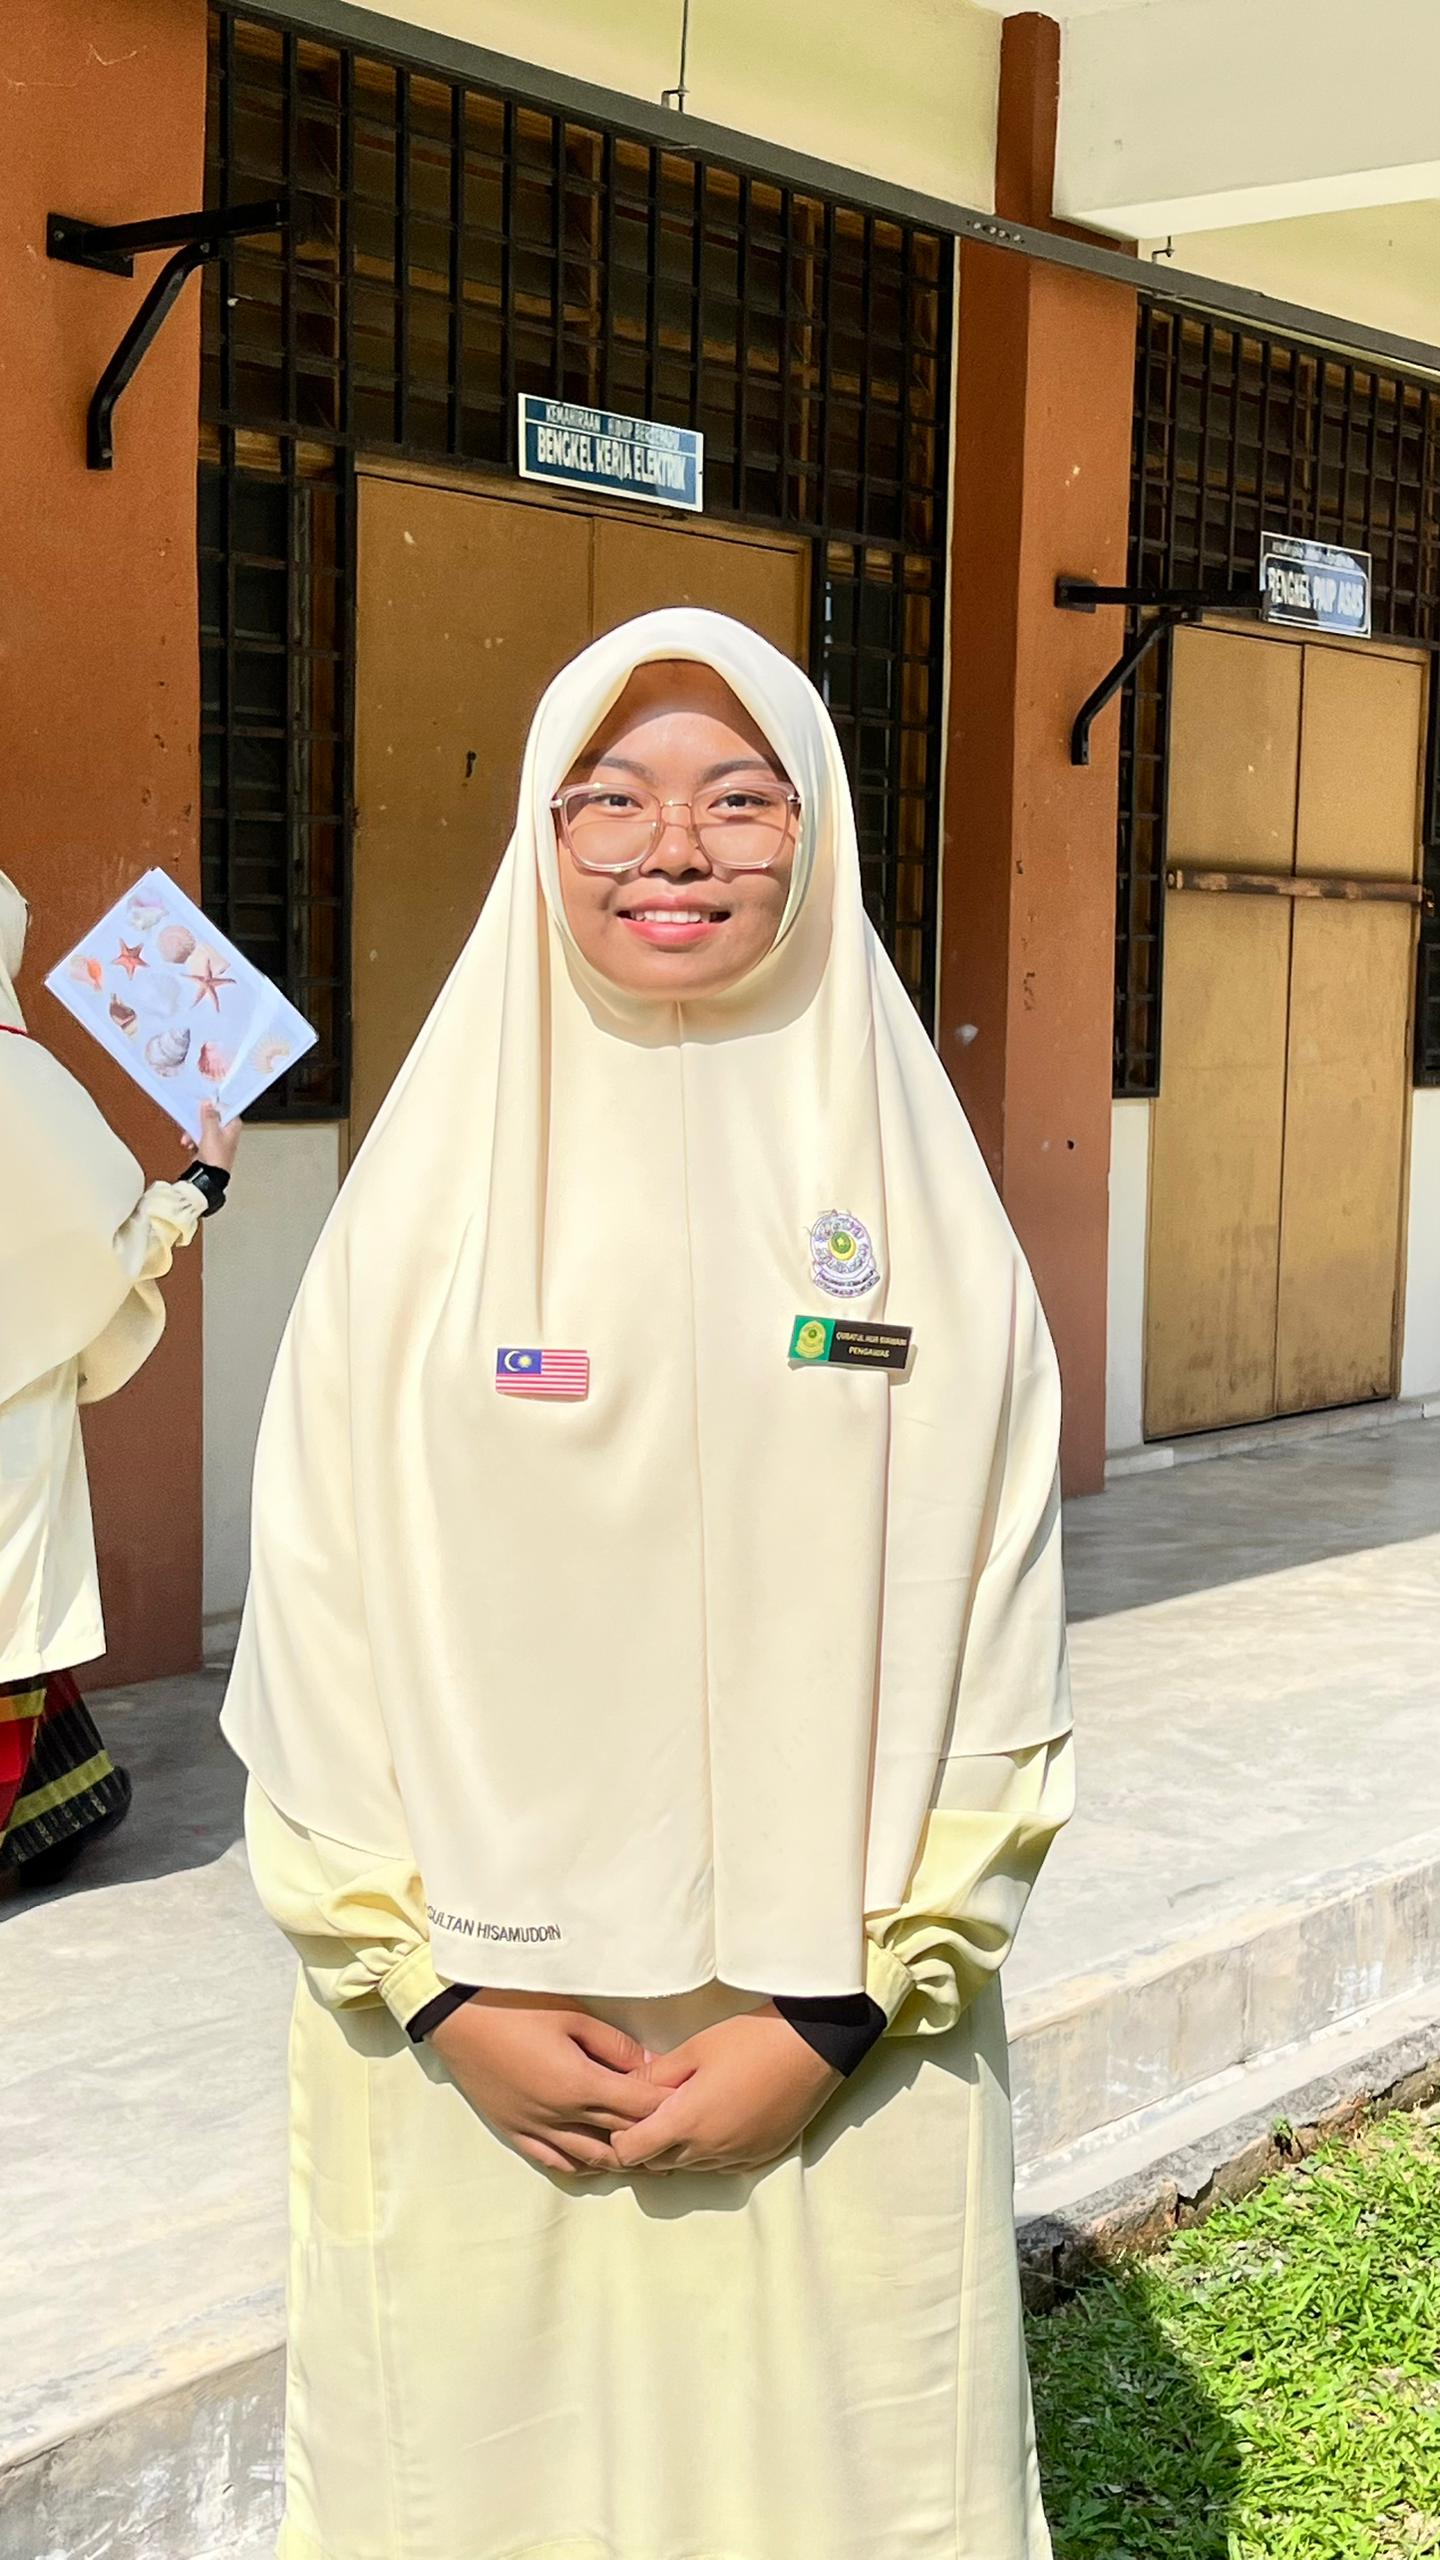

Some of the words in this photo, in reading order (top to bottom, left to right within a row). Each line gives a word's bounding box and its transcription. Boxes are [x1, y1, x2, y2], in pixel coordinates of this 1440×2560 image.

[537, 425, 594, 472] BENGKEL
[596, 437, 633, 482] KERJA
[634, 446, 686, 490] ELEKTRIK
[848, 1346, 890, 1358] PENGAWAS
[427, 1905, 474, 1936] SULTAN
[477, 1921, 562, 1942] HISAMUDDIN
